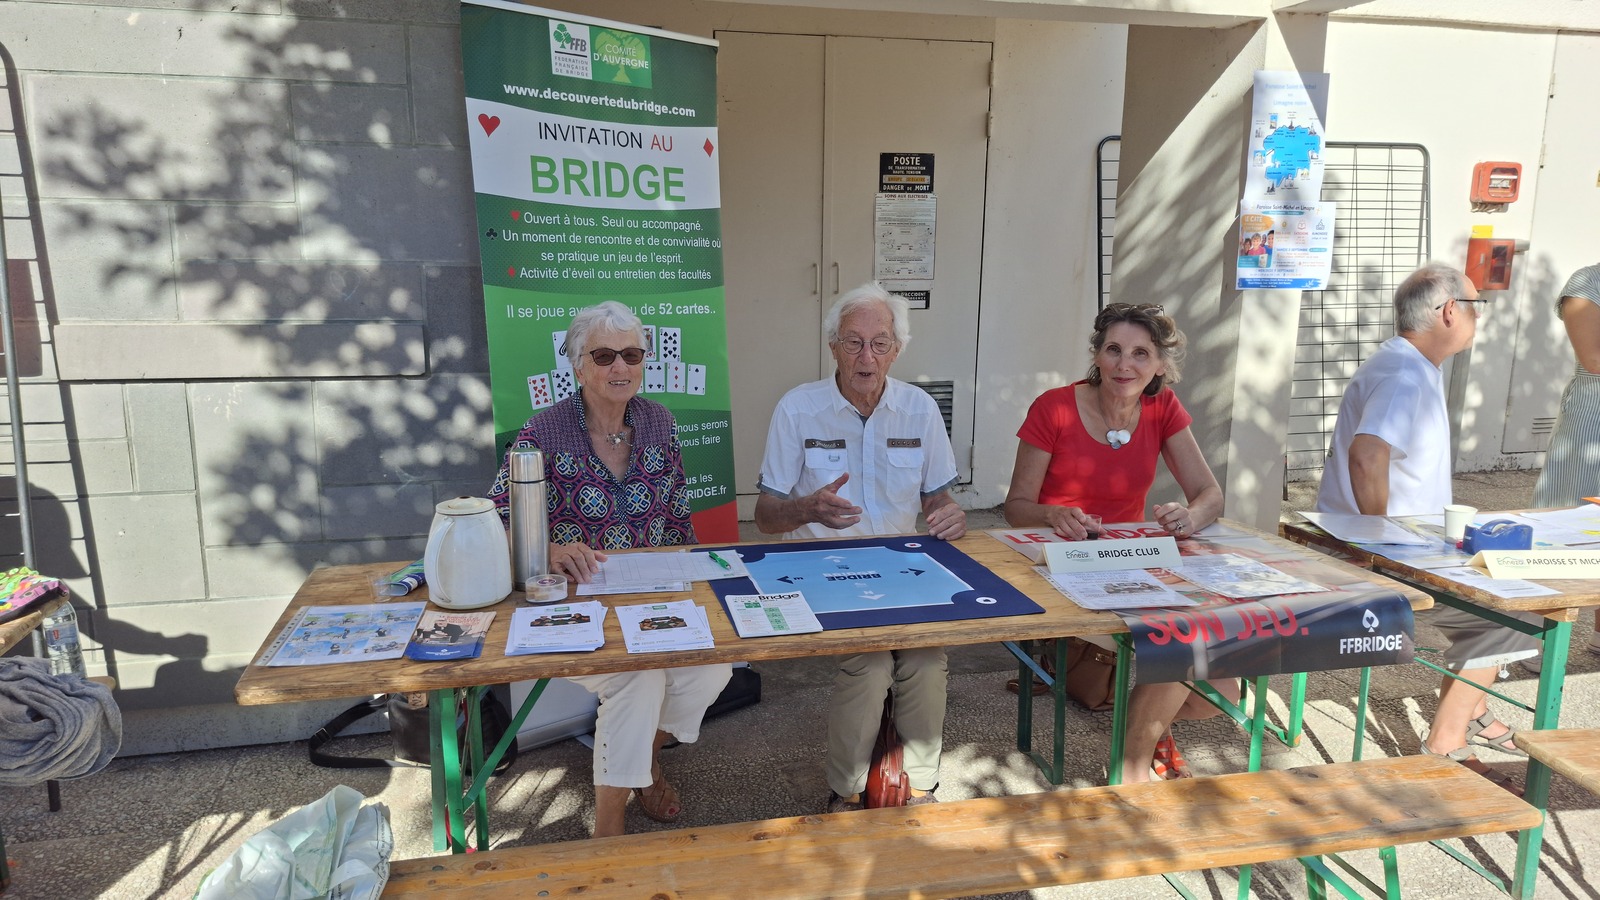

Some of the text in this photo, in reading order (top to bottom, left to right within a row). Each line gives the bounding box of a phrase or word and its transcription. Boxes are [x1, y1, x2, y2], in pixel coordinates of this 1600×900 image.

[570, 38, 587, 52] FFB
[605, 44, 636, 56] COMITÉ
[593, 53, 649, 69] D'AUVERGNE
[566, 69, 588, 77] BRIDGE
[503, 84, 696, 118] www.decouvertedubridge.com
[538, 121, 673, 152] INVITATION AU
[893, 156, 921, 166] POSTE
[530, 155, 686, 203] BRIDGE
[524, 211, 704, 233] Ouvert à tous. Seul ou accompagné.
[502, 229, 722, 248] Un moment de rencontre et de convivialité où
[541, 250, 684, 265] se pratique un jeu de l'esprit.
[520, 266, 712, 279] Activité d'éveil ou entretien des facultés
[518, 307, 533, 318] se
[536, 304, 565, 321] joue
[640, 303, 656, 315] de
[658, 302, 673, 315] 52
[677, 420, 729, 433] nous serons
[680, 434, 721, 447] vous faire
[685, 473, 713, 485] us les
[686, 484, 727, 500] RIDGE.fr
[1005, 533, 1048, 544] LE
[1097, 549, 1134, 559] BRIDGE
[1135, 547, 1161, 556] CLUB
[1141, 604, 1310, 645] SON JEU.
[1339, 634, 1403, 655] FFBRIDGE
